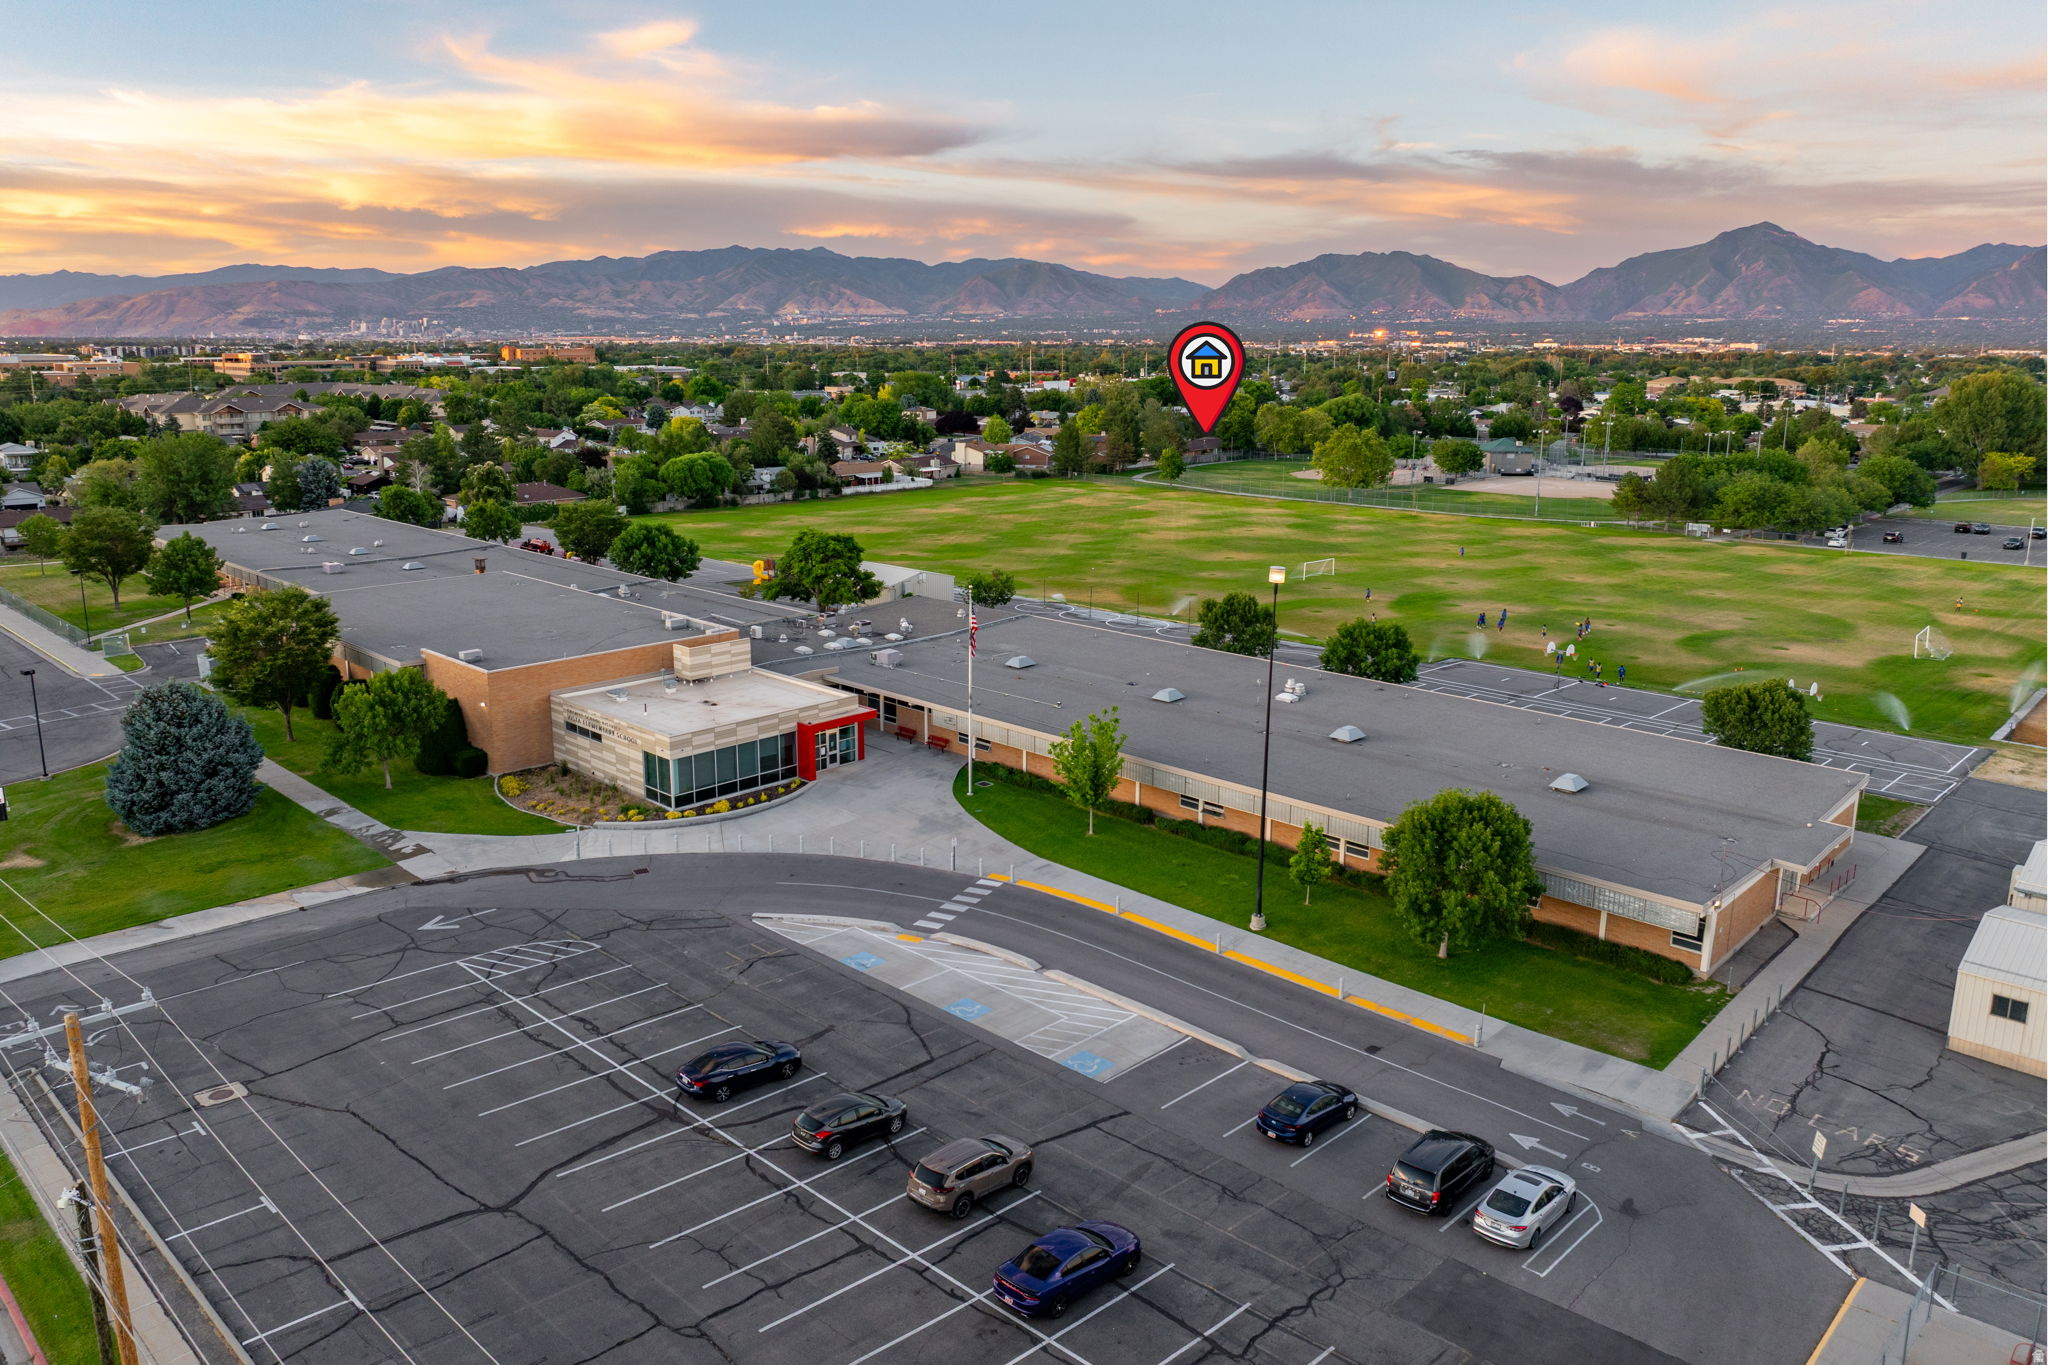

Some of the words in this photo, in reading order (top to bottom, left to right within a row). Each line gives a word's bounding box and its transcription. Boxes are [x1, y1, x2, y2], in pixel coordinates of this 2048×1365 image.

[583, 720, 615, 736] ELEMENTARY
[617, 732, 638, 745] SCHOOL
[1736, 1089, 1792, 1115] NO
[1807, 1113, 1926, 1163] CARS
[1581, 1162, 1602, 1173] B
